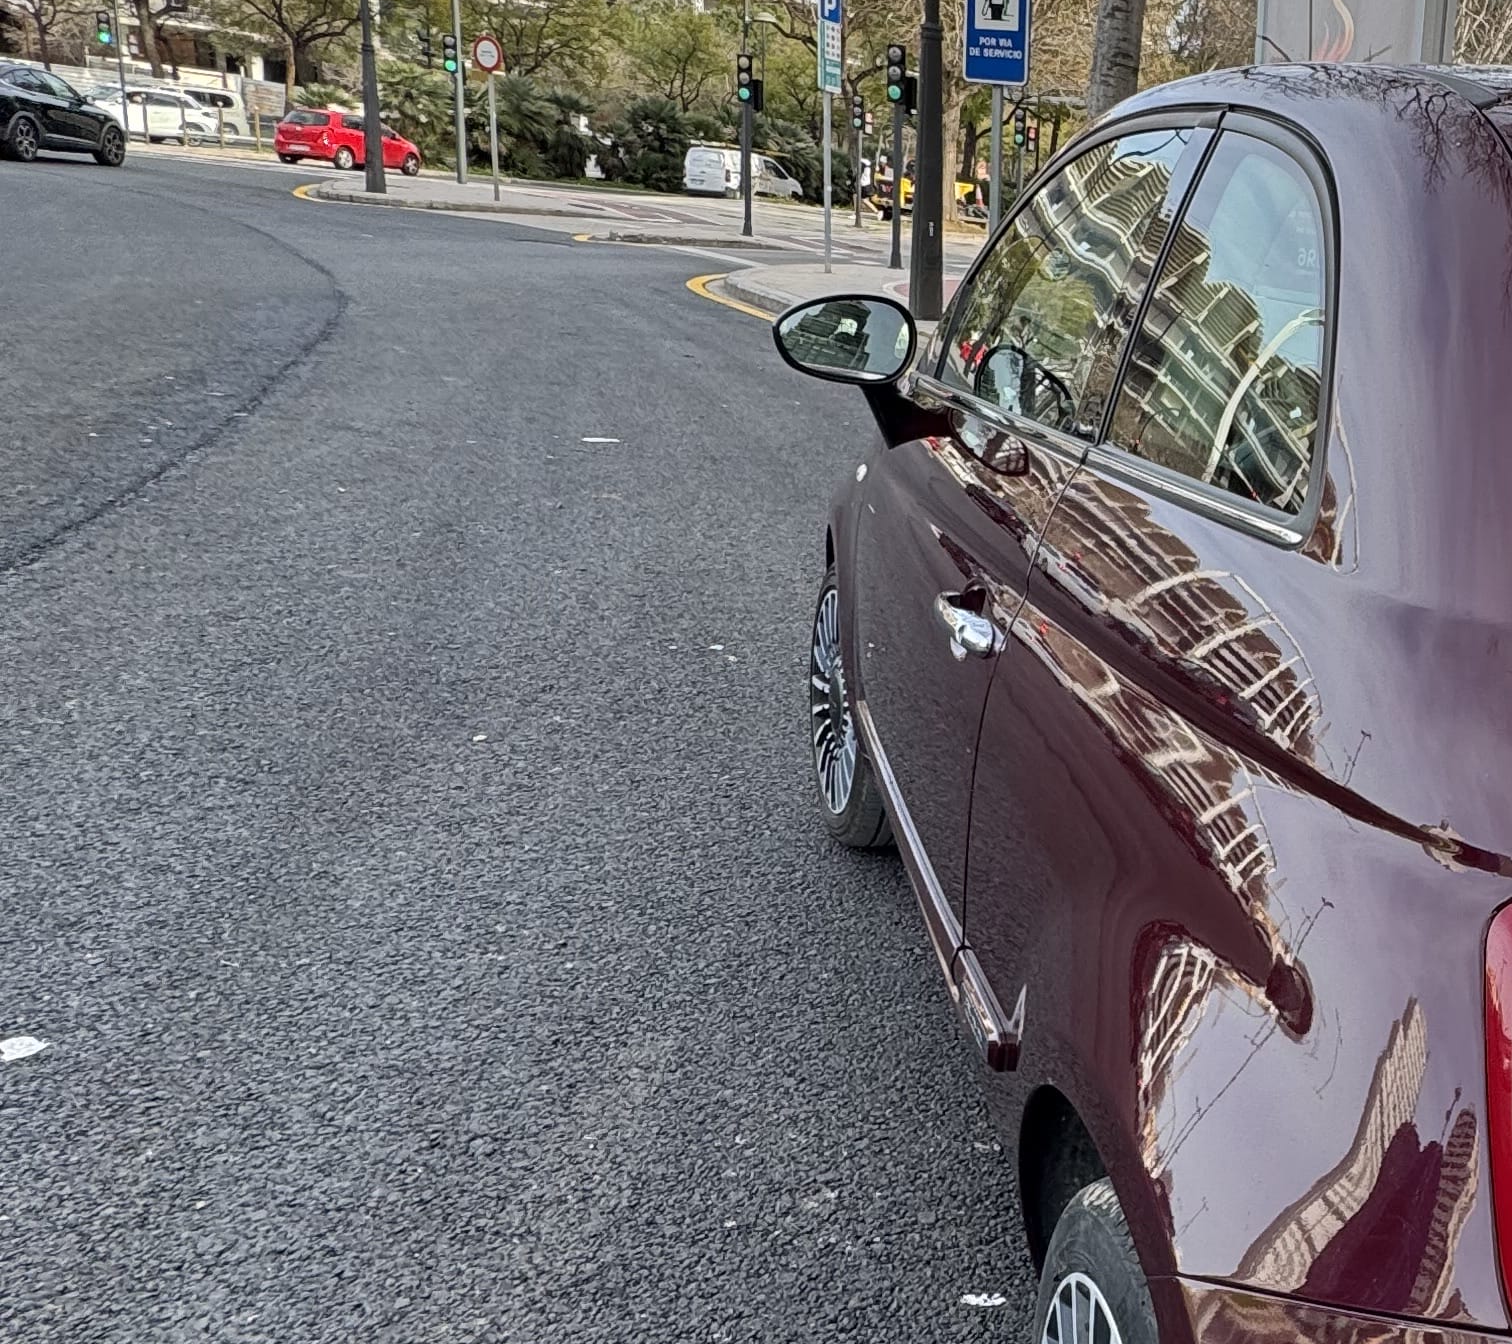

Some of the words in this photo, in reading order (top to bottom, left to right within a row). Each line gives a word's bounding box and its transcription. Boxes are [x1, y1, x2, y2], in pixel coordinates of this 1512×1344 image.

[979, 37, 996, 46] POR
[969, 47, 980, 57] DE
[983, 48, 1022, 60] SERVICIO
